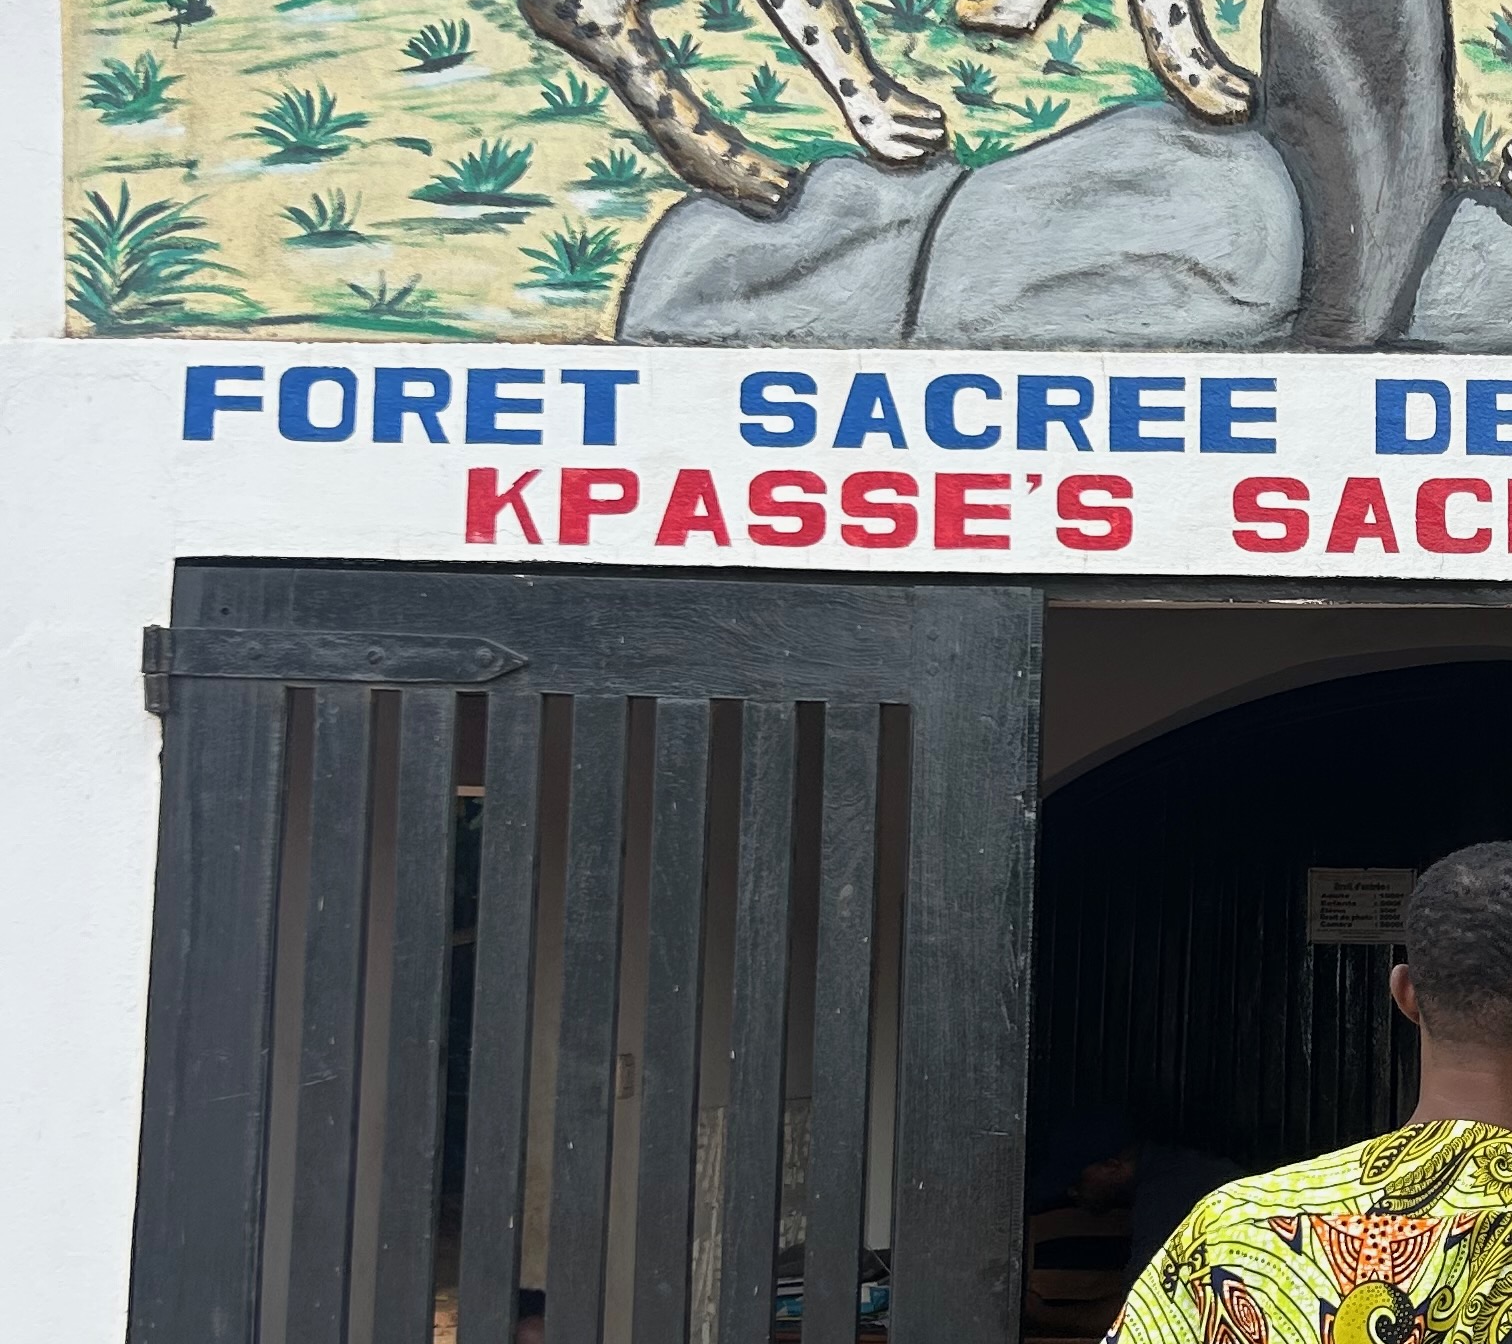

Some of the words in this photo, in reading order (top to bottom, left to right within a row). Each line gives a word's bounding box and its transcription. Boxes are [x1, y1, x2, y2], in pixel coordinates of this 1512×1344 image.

[183, 365, 640, 446] FORET
[739, 371, 1277, 453] SACREE
[464, 467, 1134, 552] KPASSE'S
